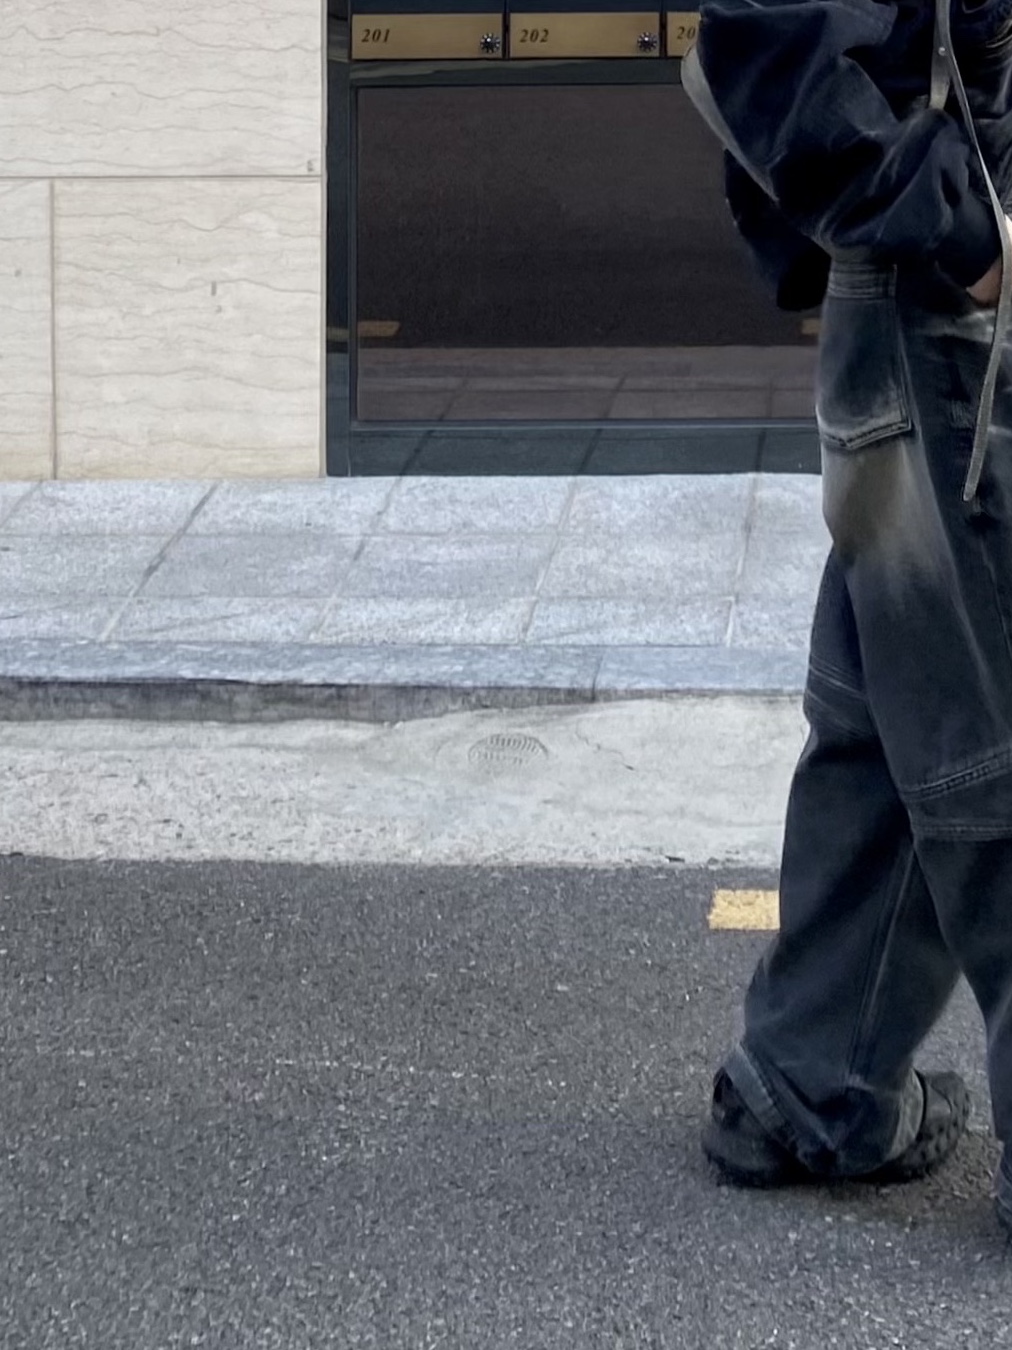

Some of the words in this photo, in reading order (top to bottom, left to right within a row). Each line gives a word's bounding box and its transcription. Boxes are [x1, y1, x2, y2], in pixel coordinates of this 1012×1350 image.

[360, 28, 391, 42] 201
[518, 28, 549, 42] 202
[676, 26, 696, 40] 20
